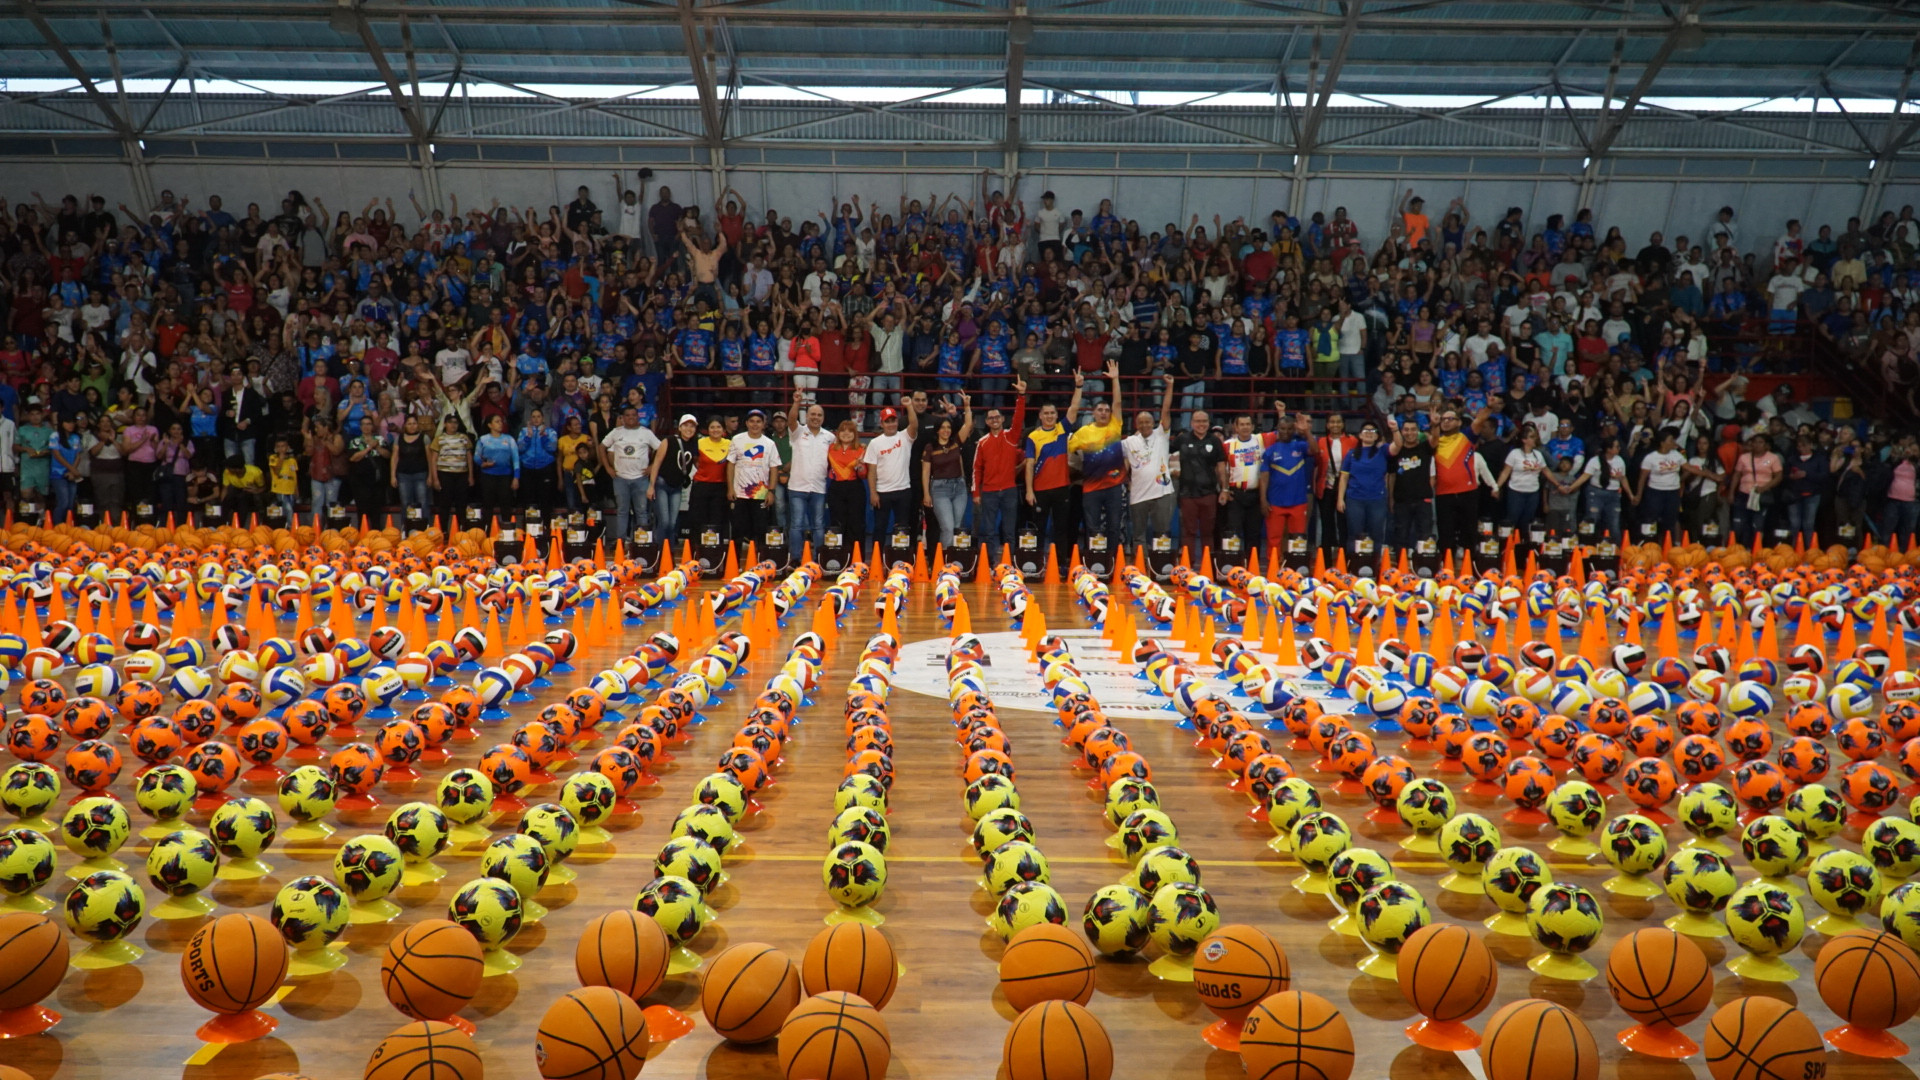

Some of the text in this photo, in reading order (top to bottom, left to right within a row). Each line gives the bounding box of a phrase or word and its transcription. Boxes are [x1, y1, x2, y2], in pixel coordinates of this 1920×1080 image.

[189, 929, 215, 993] SPORTS
[1195, 980, 1242, 999] SPORT
[1803, 1060, 1827, 1080] SPO
